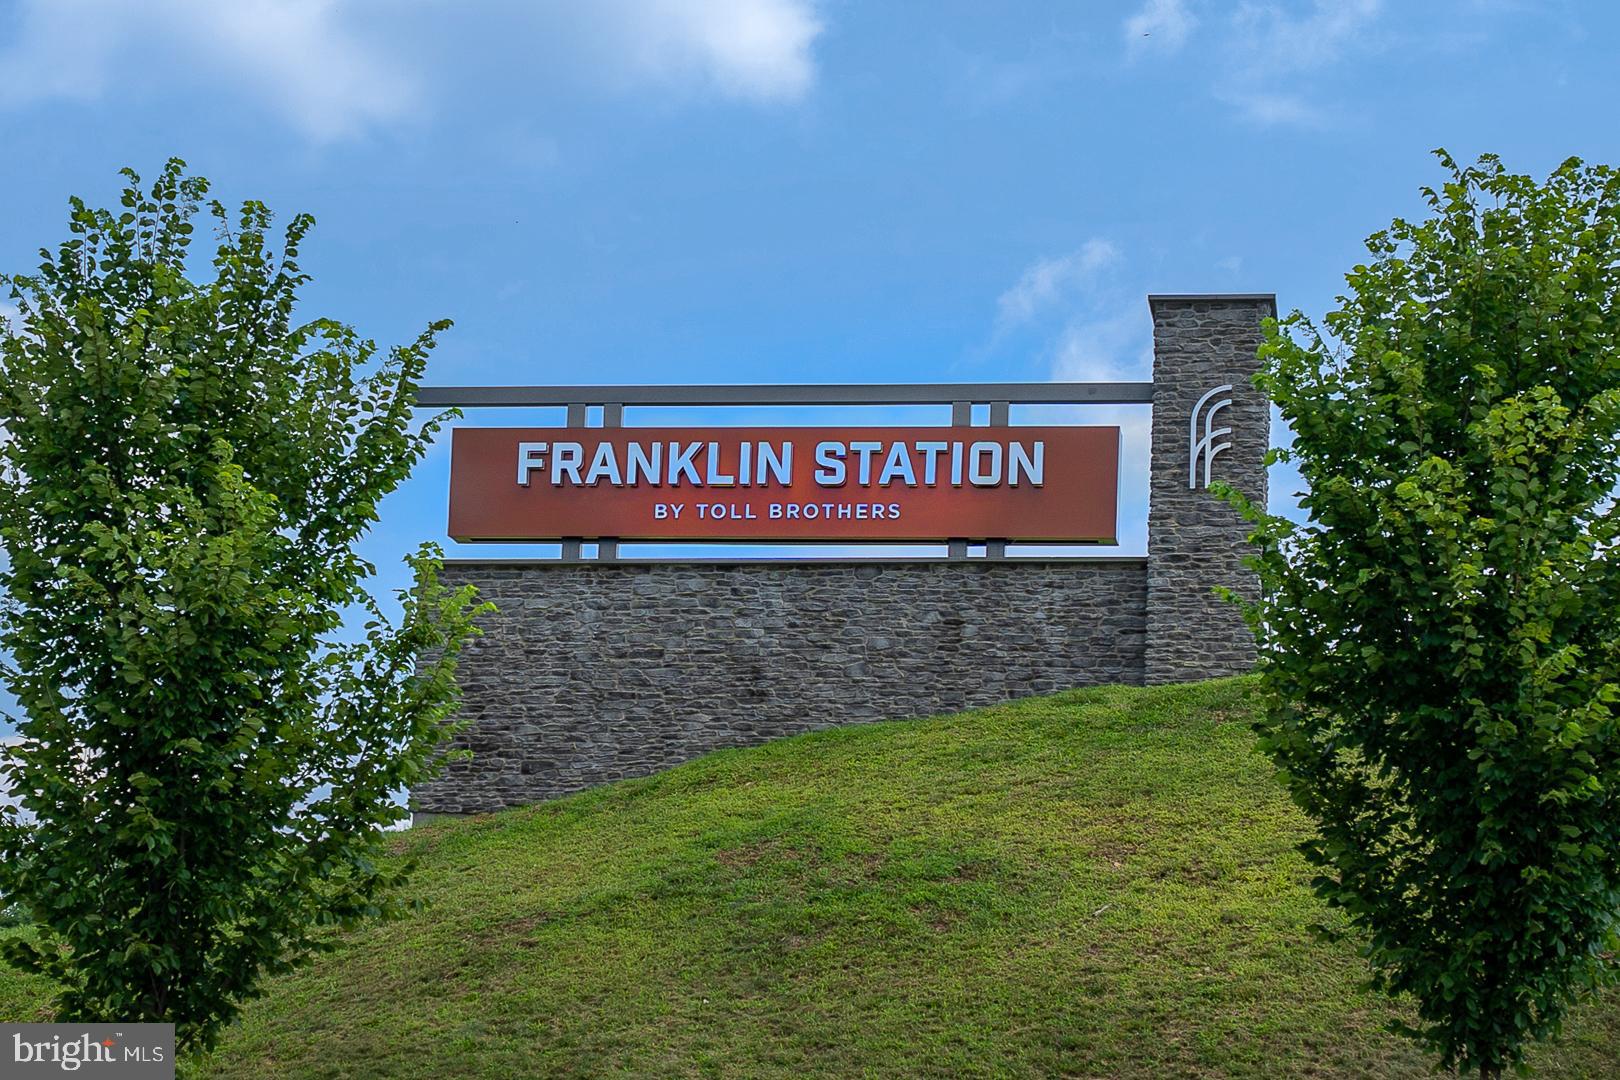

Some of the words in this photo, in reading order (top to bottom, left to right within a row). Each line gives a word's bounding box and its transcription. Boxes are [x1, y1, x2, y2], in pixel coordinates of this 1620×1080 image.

[516, 441, 793, 487] FRANKLIN
[813, 441, 1045, 487] STATION
[654, 503, 684, 519] BY
[695, 503, 757, 519] TOLL
[769, 503, 901, 519] BROTHERS
